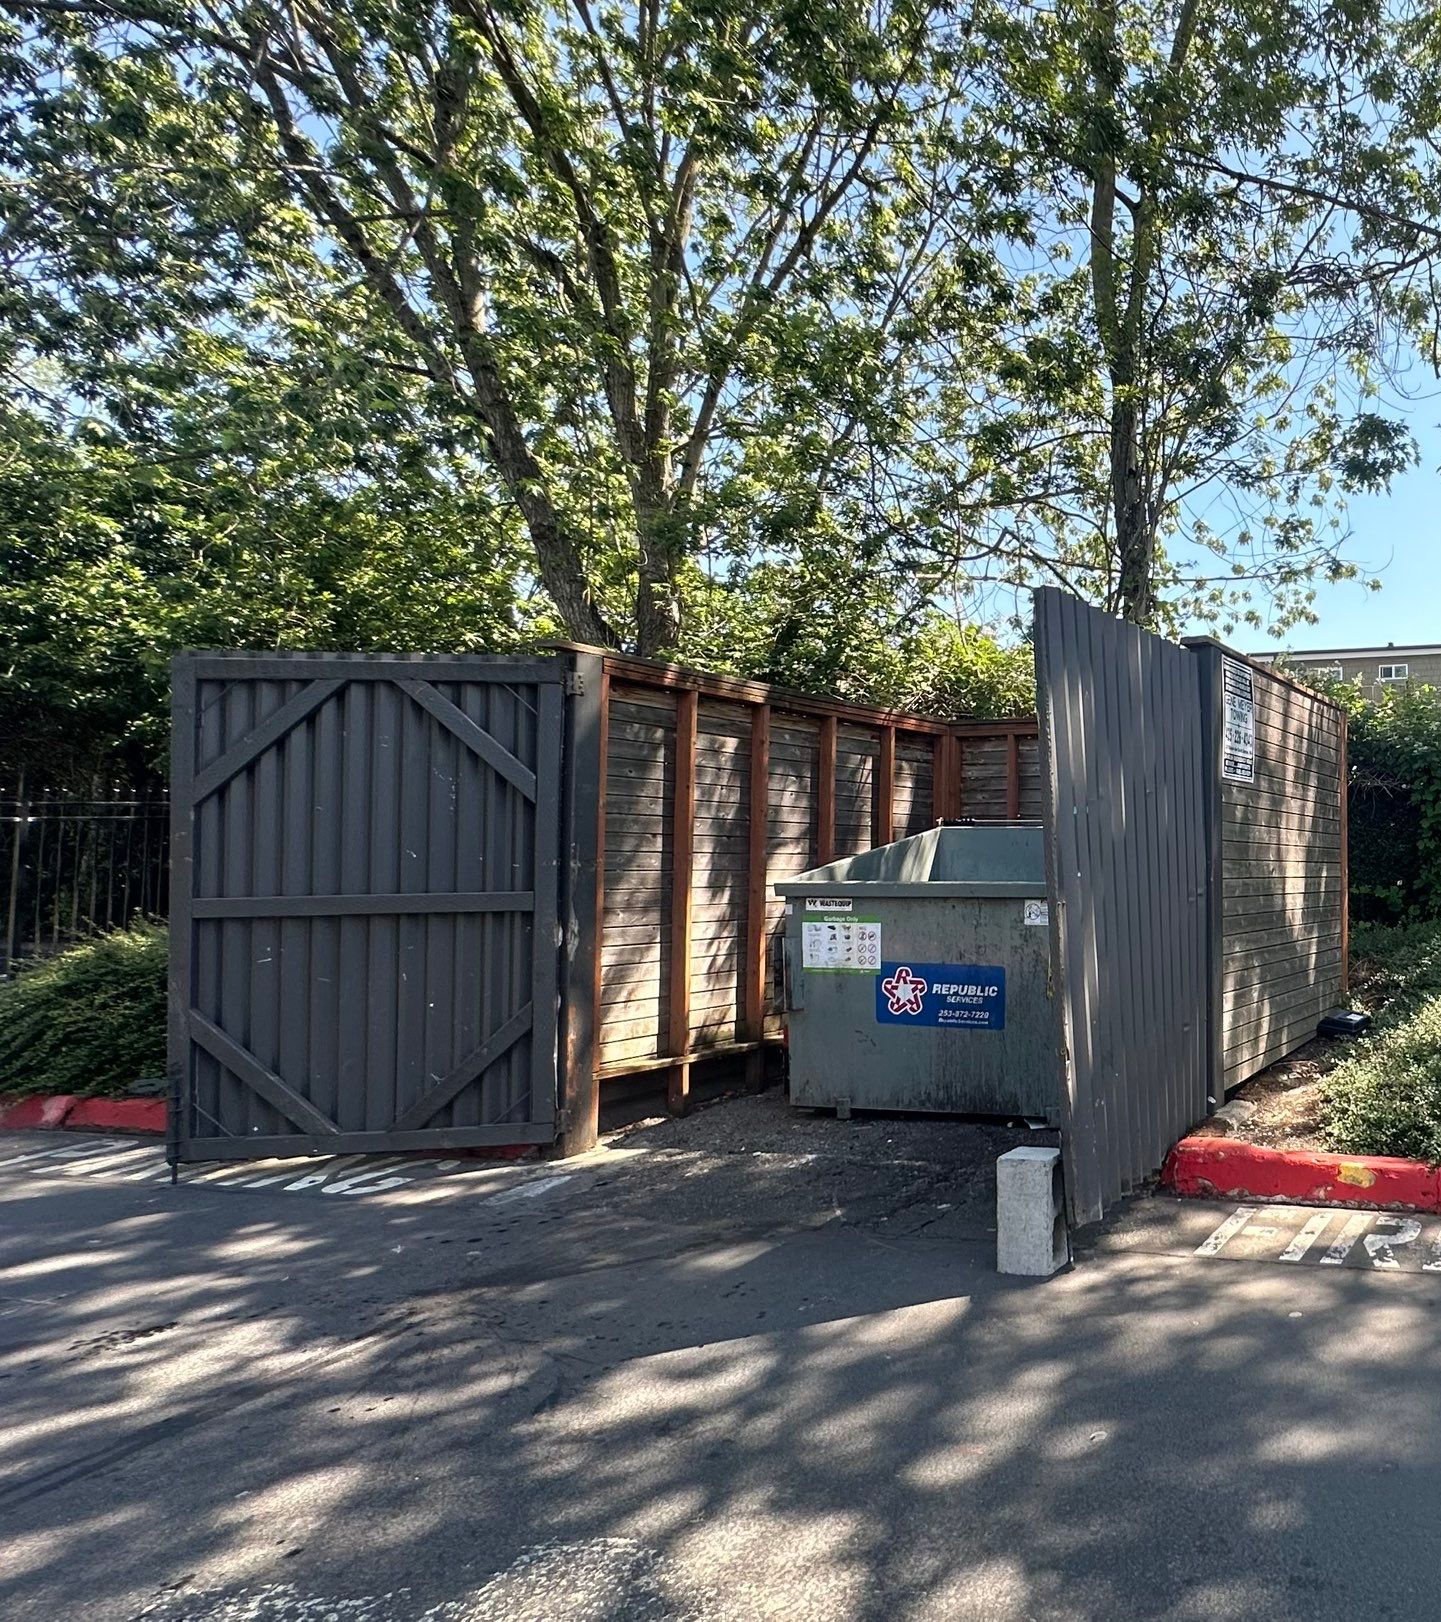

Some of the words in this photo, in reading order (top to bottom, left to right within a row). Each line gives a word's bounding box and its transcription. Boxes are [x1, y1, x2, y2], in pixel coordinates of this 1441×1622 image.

[1230, 708, 1248, 724] TOWING
[932, 983, 998, 997] REPUBLIC
[946, 995, 984, 1004] SERVICES
